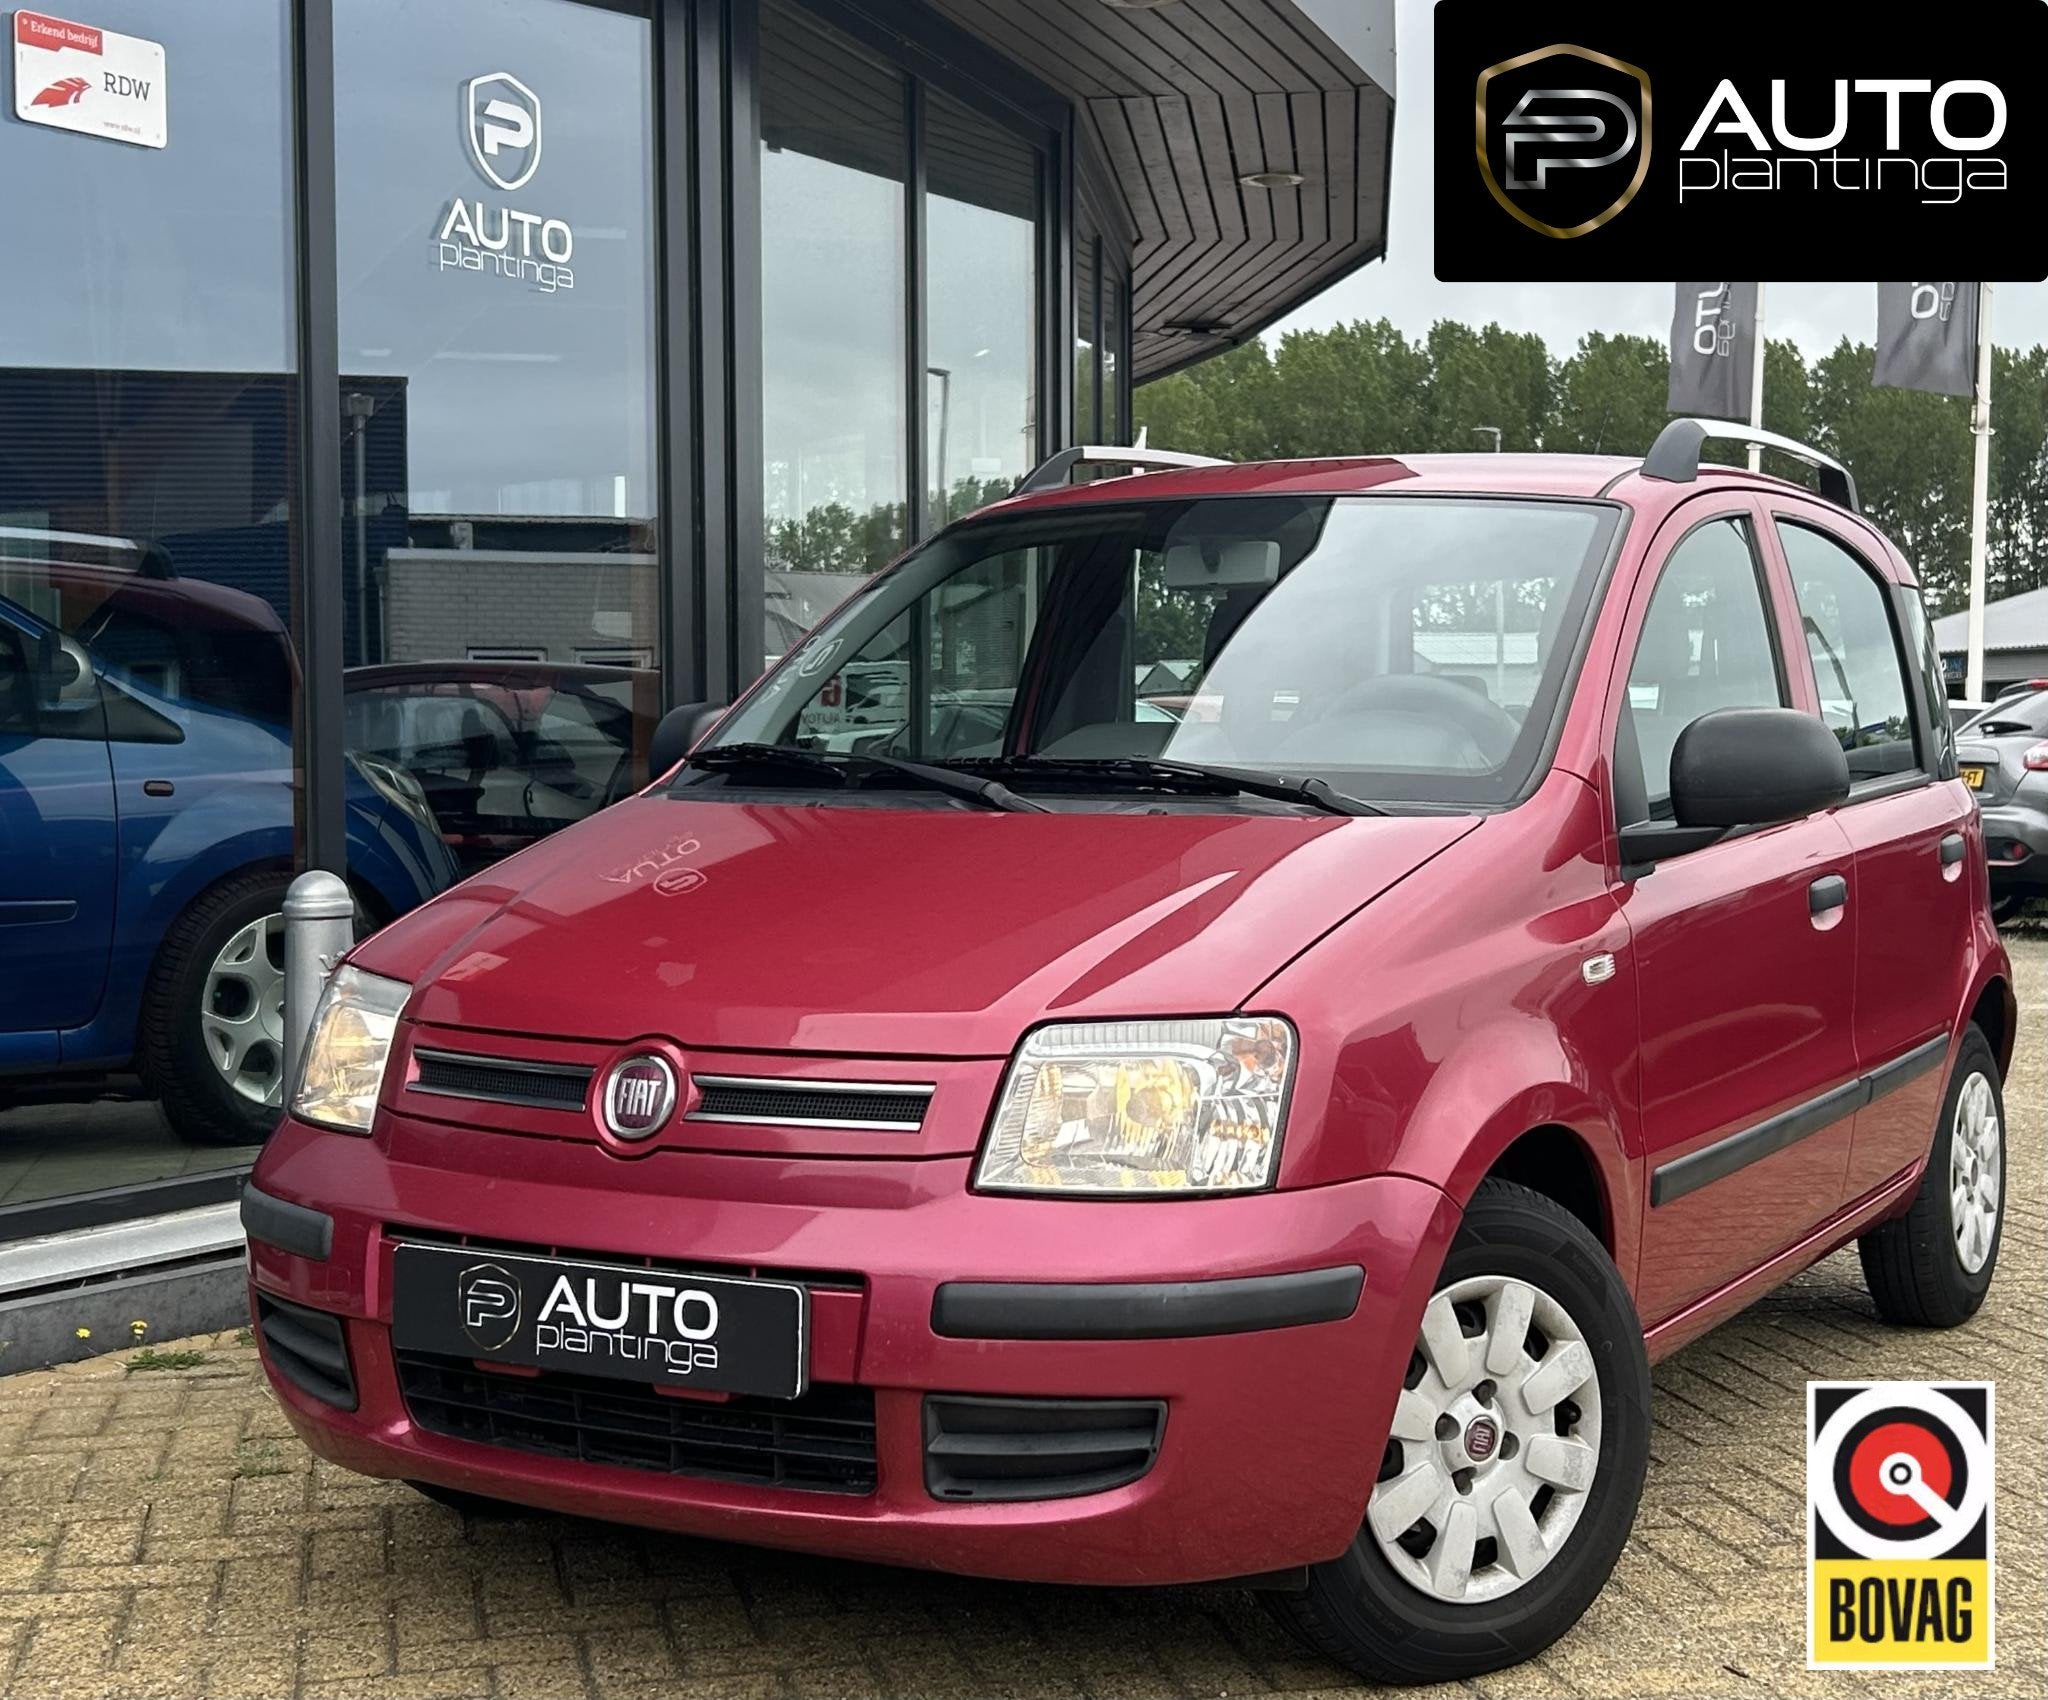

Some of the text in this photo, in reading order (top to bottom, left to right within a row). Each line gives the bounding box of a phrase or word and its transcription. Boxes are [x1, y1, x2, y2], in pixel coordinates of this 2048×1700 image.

[31, 21, 99, 48] Erkend bedrijf
[103, 72, 151, 102] RDW
[440, 198, 573, 263] AUTO
[439, 242, 574, 293] plantinga
[617, 1077, 662, 1116] FIAT
[537, 1274, 719, 1341] AUTO
[535, 1320, 719, 1375] plantinga
[1472, 1425, 1491, 1453] FIAT
